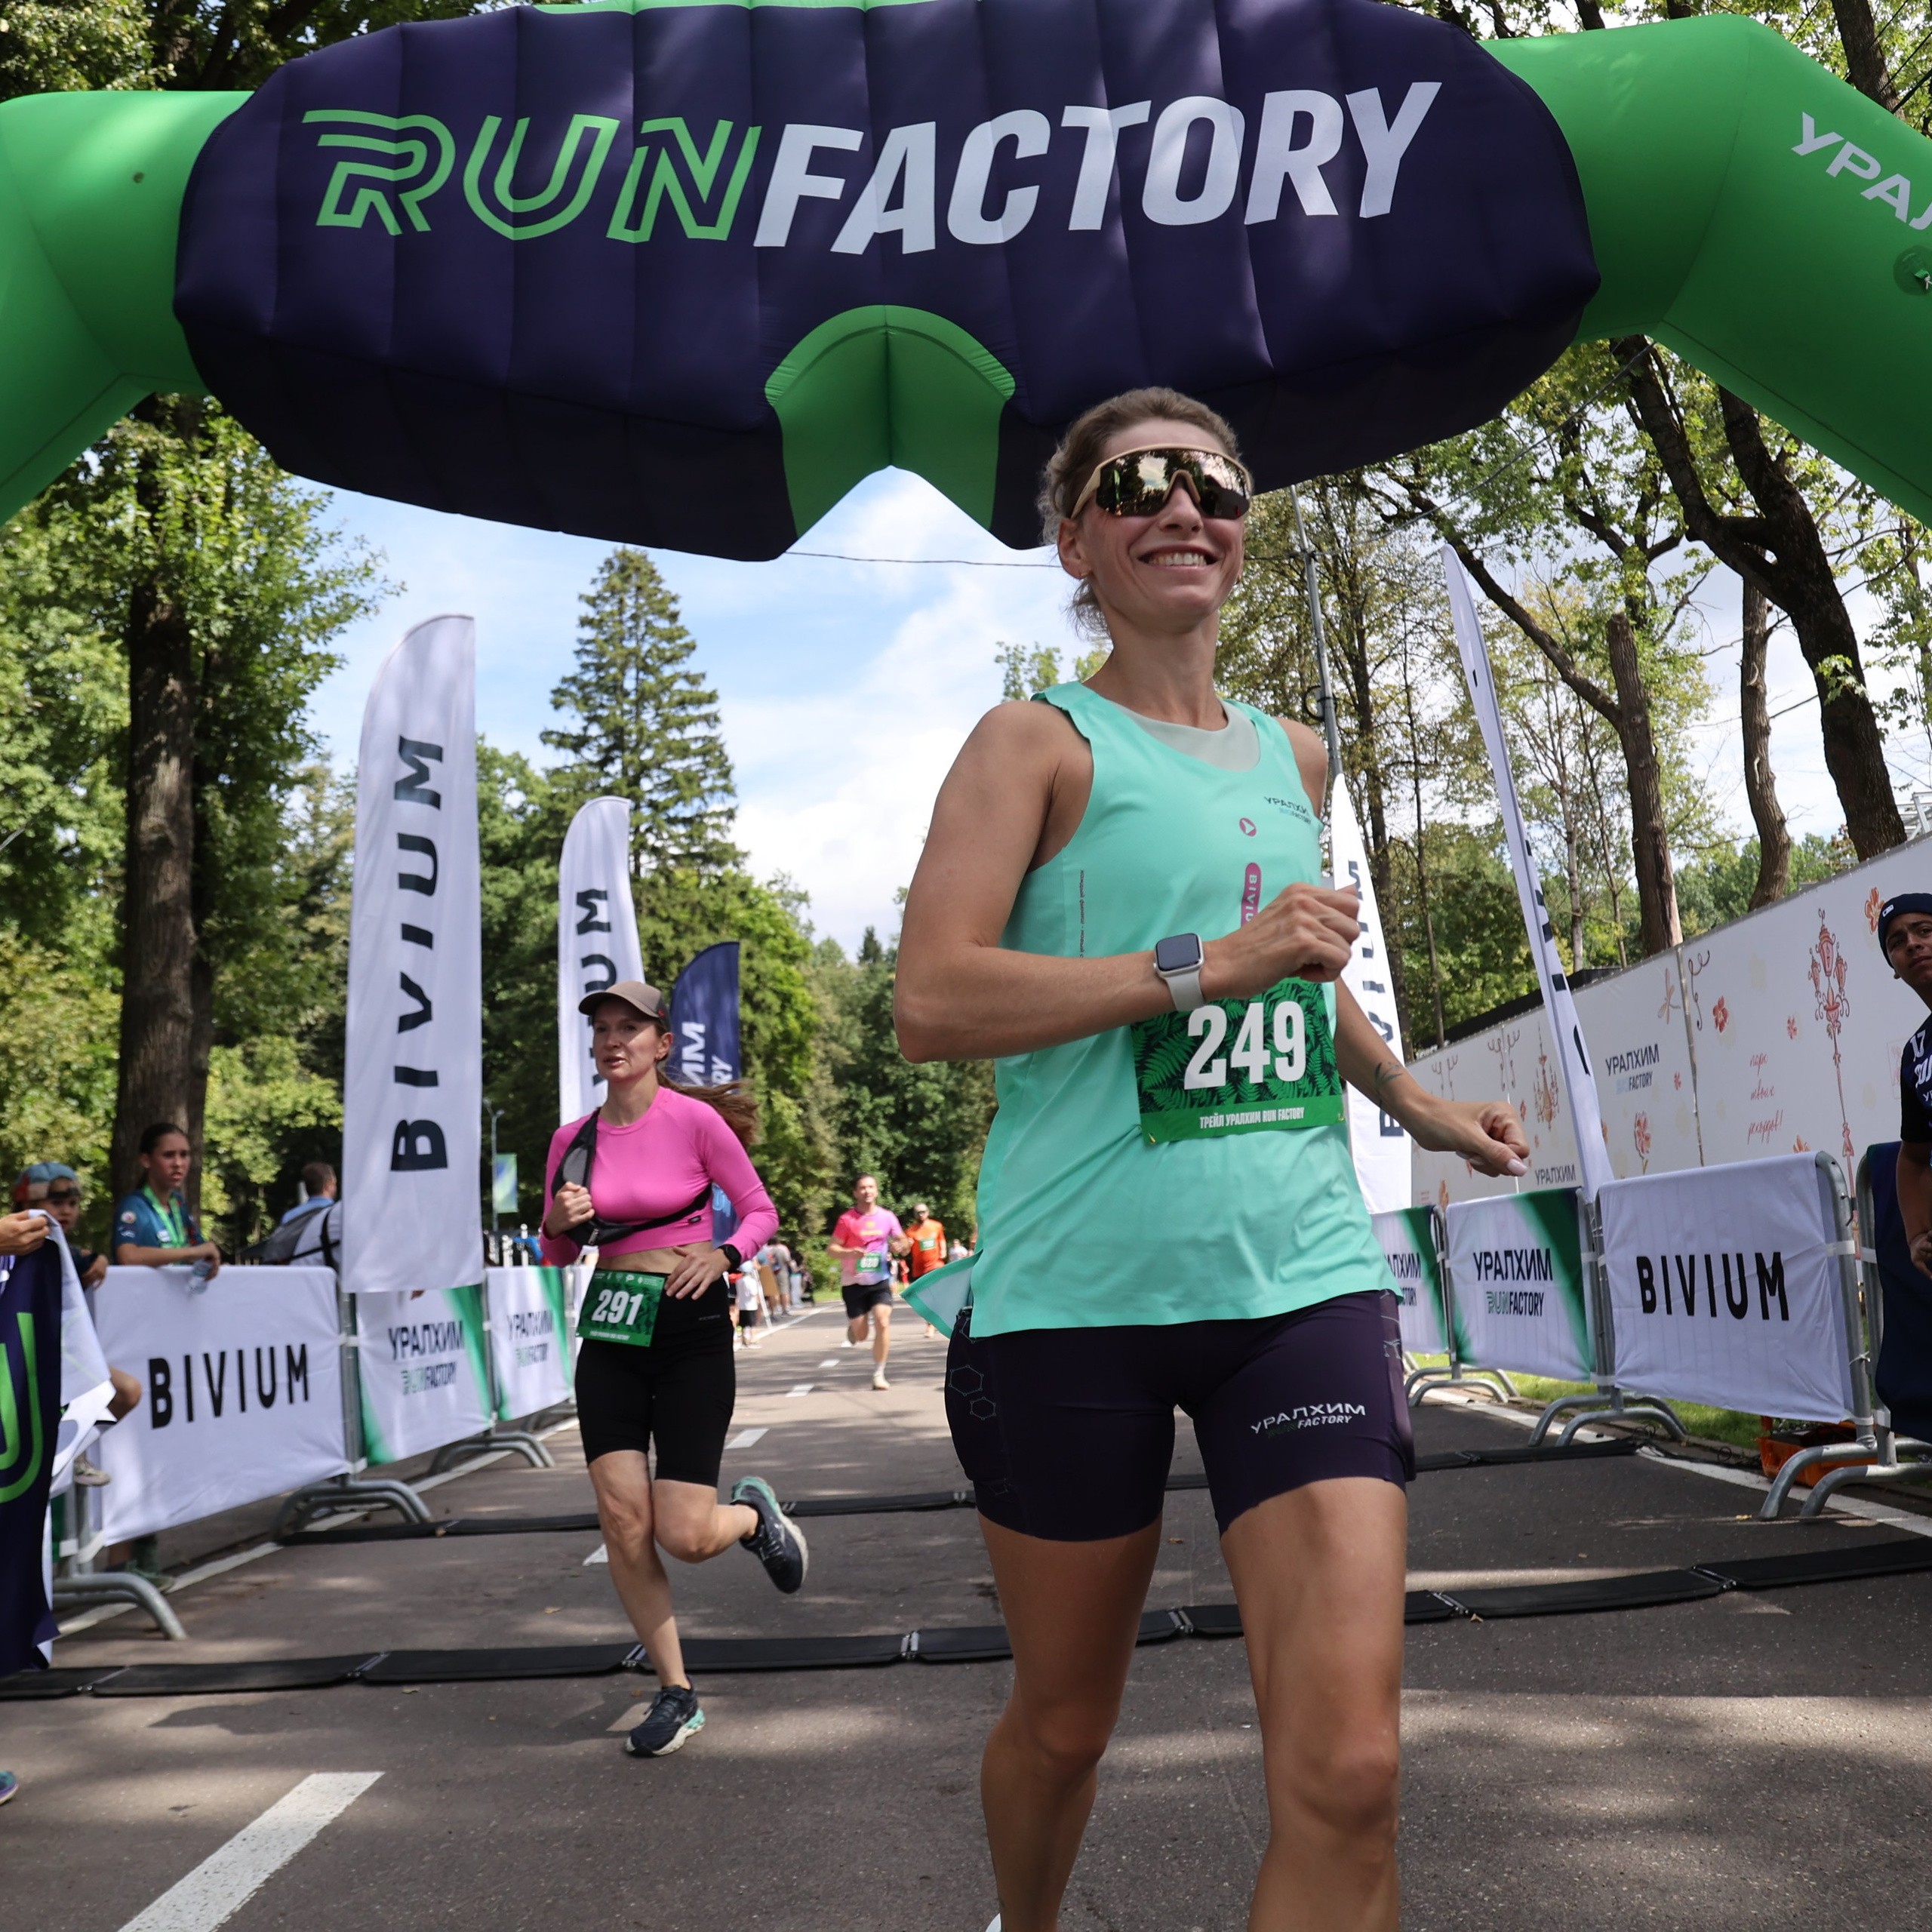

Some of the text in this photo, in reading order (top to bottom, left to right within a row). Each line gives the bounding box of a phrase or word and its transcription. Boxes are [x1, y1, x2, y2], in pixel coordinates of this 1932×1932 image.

[1245, 873, 1258, 922] BIVIU
[390, 734, 448, 1172] BIVIUM
[1183, 1001, 1306, 1091] 249
[1605, 1043, 1660, 1077] УРАЛХИМ
[1199, 1107, 1305, 1129] ТРЕЙЛ УРАЛХИМ RUN FACTORY
[1534, 1165, 1577, 1186] УРАЛХИМ
[1385, 1252, 1422, 1278] АЛХИМ
[1473, 1247, 1553, 1281] УРАЛХИМ
[1636, 1251, 1789, 1321] BIVIUM
[591, 1289, 644, 1326] 291
[388, 1320, 465, 1361] УРАЛХИМ
[149, 1343, 309, 1430] BIVIUM
[1250, 1402, 1367, 1435] УРАЛХИМ
